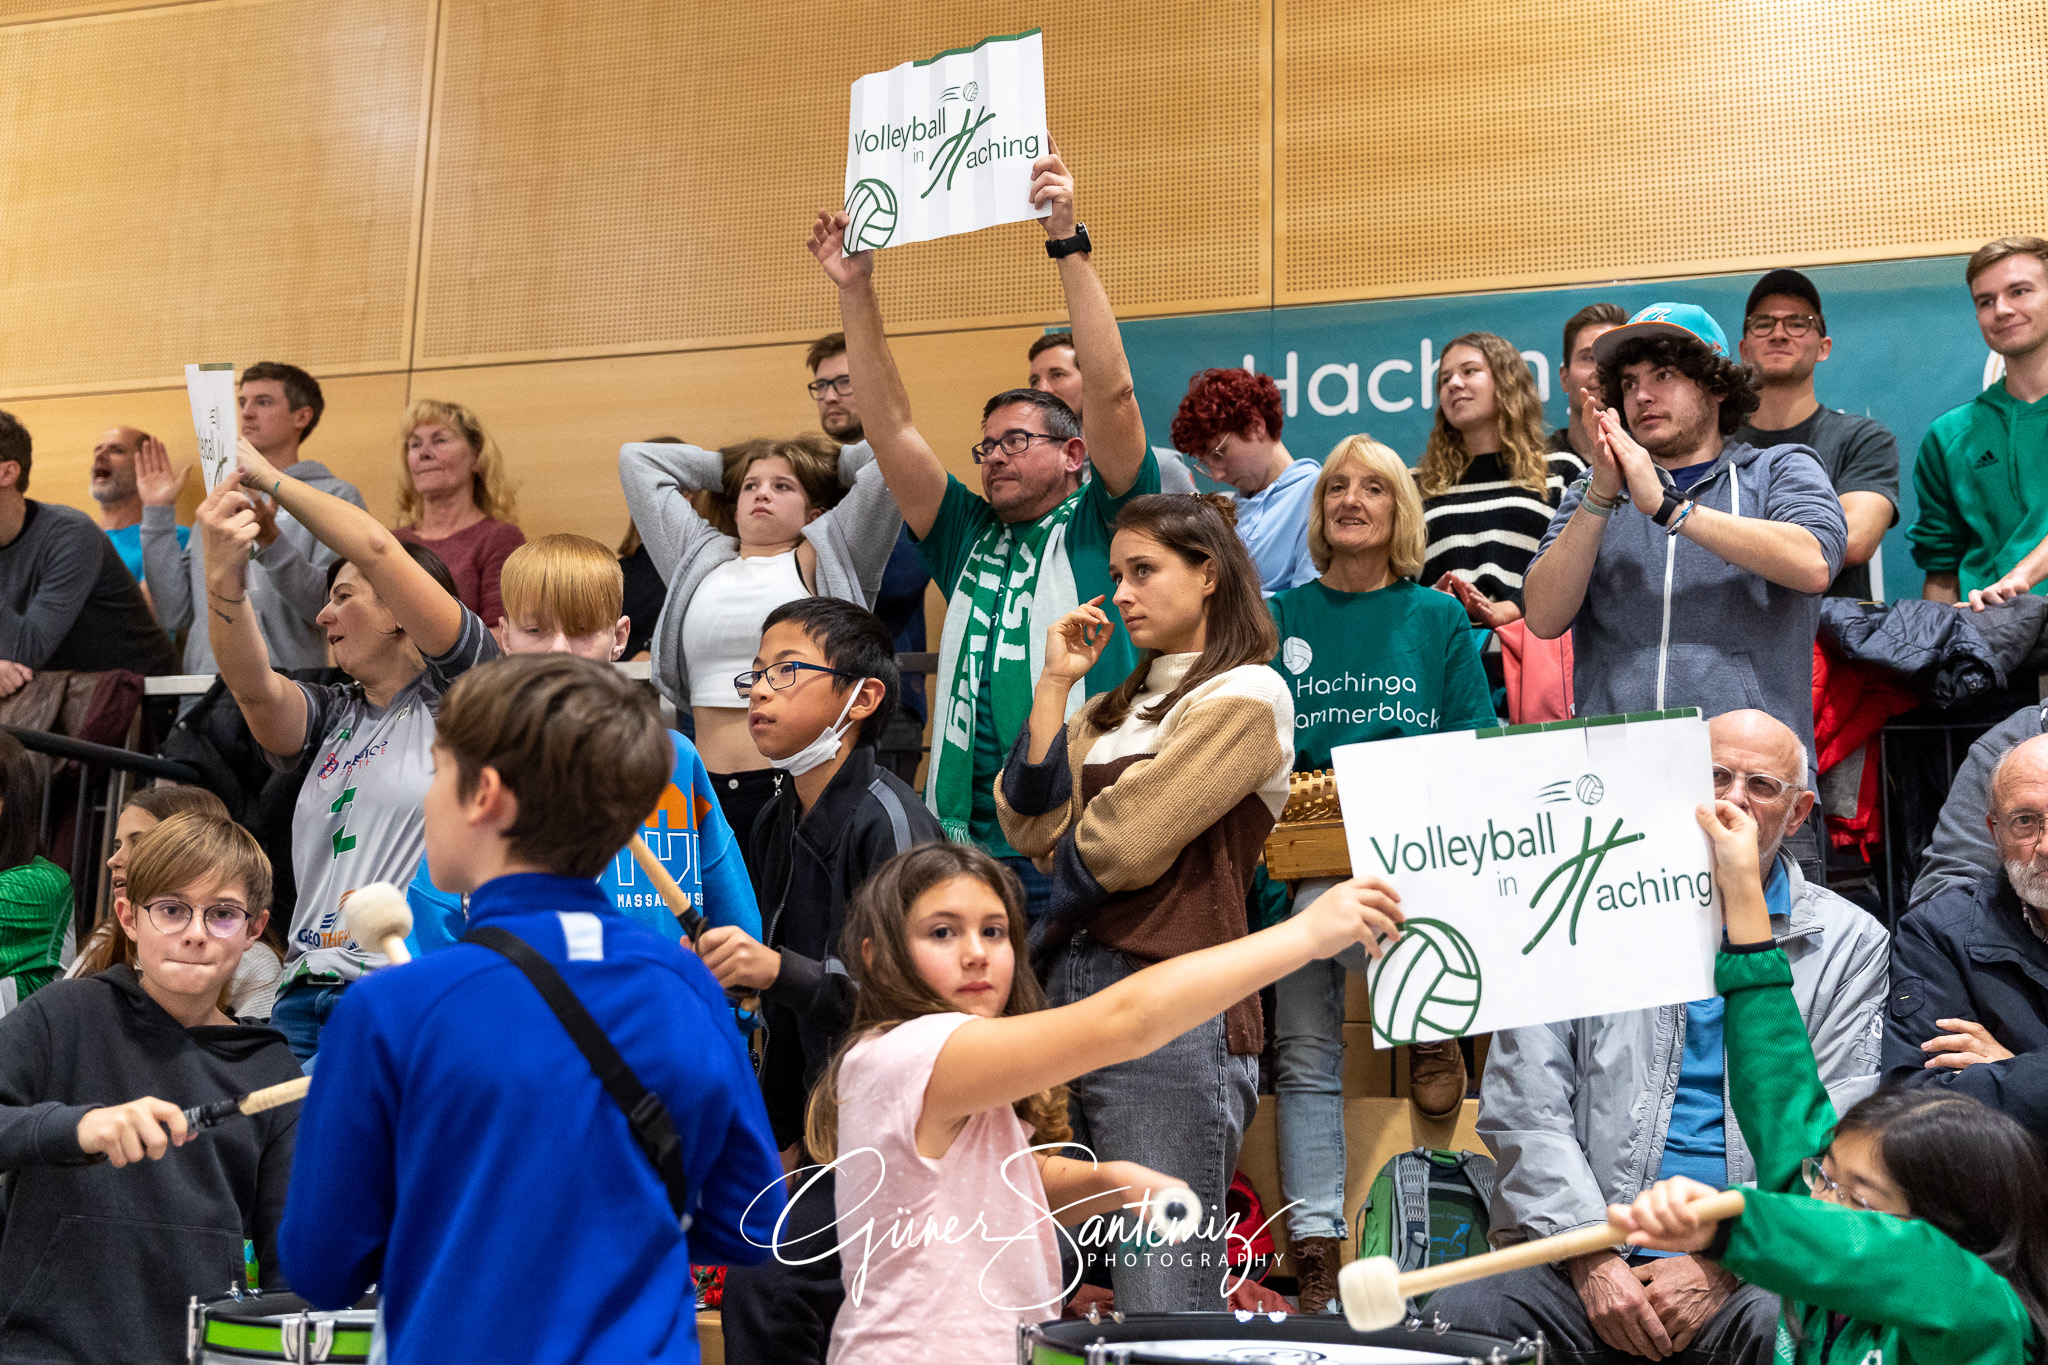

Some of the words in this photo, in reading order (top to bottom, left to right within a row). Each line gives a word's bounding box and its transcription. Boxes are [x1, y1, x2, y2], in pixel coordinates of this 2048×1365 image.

[855, 107, 946, 155] Volleyball
[913, 148, 924, 163] in
[1297, 671, 1417, 698] Hachinga
[1293, 701, 1441, 730] ammerblock
[1370, 811, 1556, 876] Volleyball
[1498, 871, 1518, 896] in
